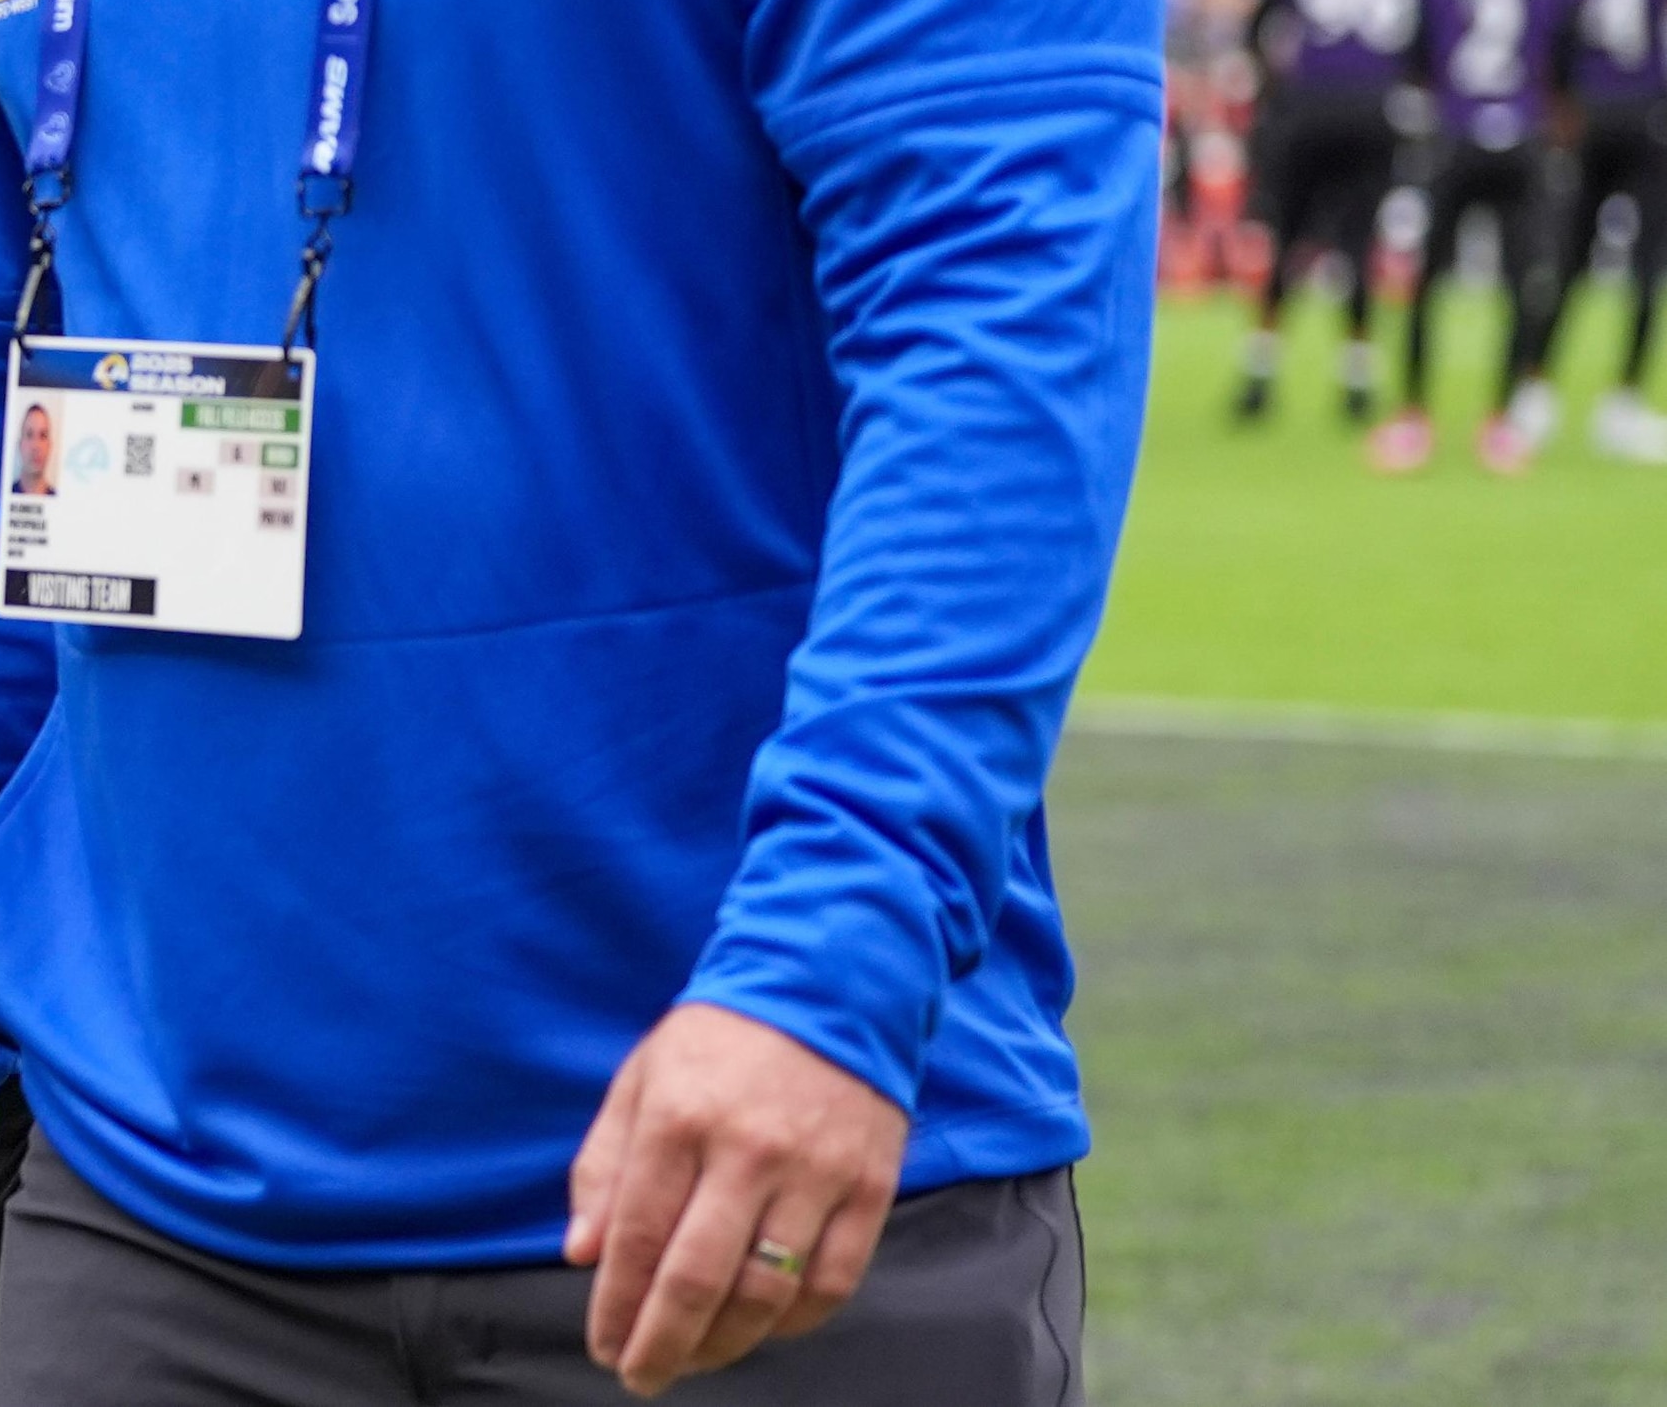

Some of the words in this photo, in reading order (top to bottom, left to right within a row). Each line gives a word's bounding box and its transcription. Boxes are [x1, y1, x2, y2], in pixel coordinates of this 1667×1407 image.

[129, 373, 226, 395] SEASON
[27, 572, 90, 611] VISITING
[90, 576, 132, 612] TEAM
